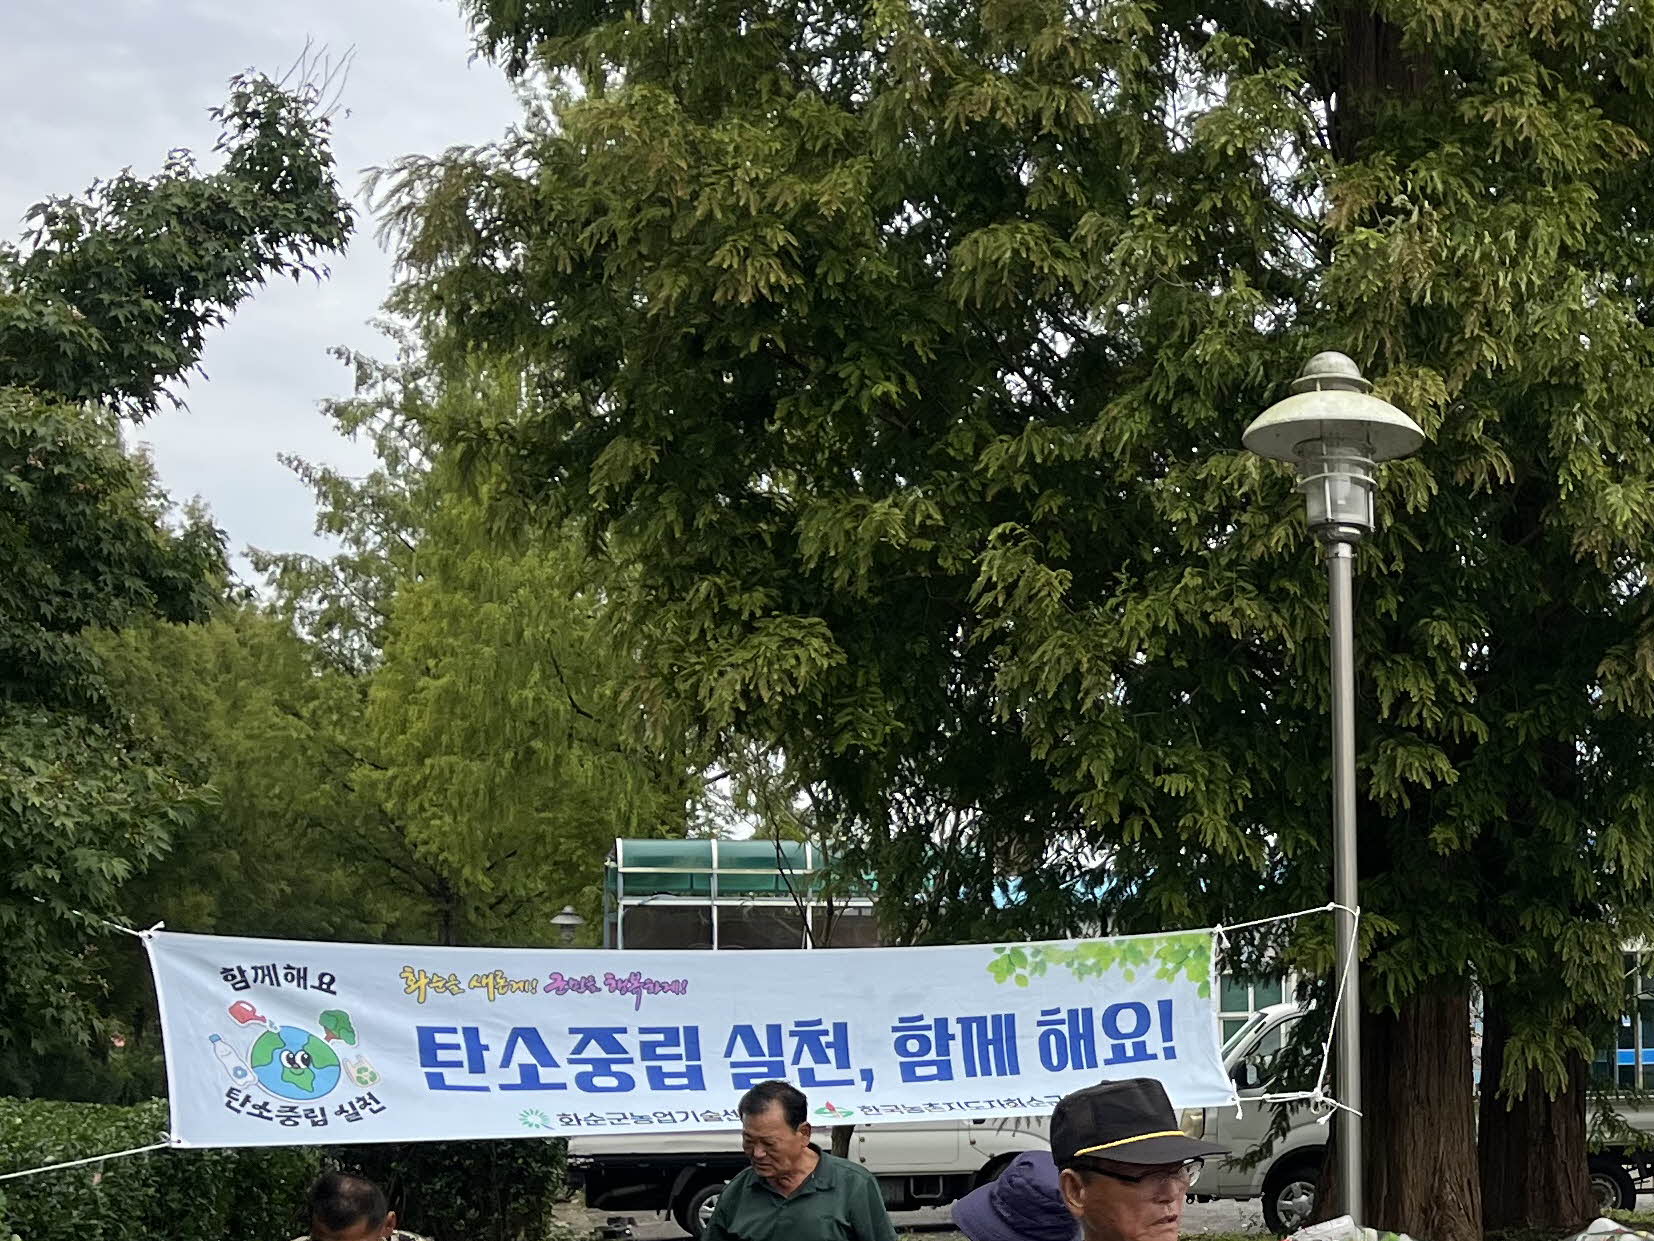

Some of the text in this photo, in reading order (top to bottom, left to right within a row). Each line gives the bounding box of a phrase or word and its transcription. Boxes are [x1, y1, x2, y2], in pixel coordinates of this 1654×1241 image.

[220, 962, 338, 996] 함께해요
[399, 965, 465, 1005] 화순을
[415, 997, 1178, 1094] 탄소중립 실천, 함께 해요!
[223, 1085, 387, 1128] 탄소중립 실천
[555, 1106, 743, 1128] 화순군농업기술센
